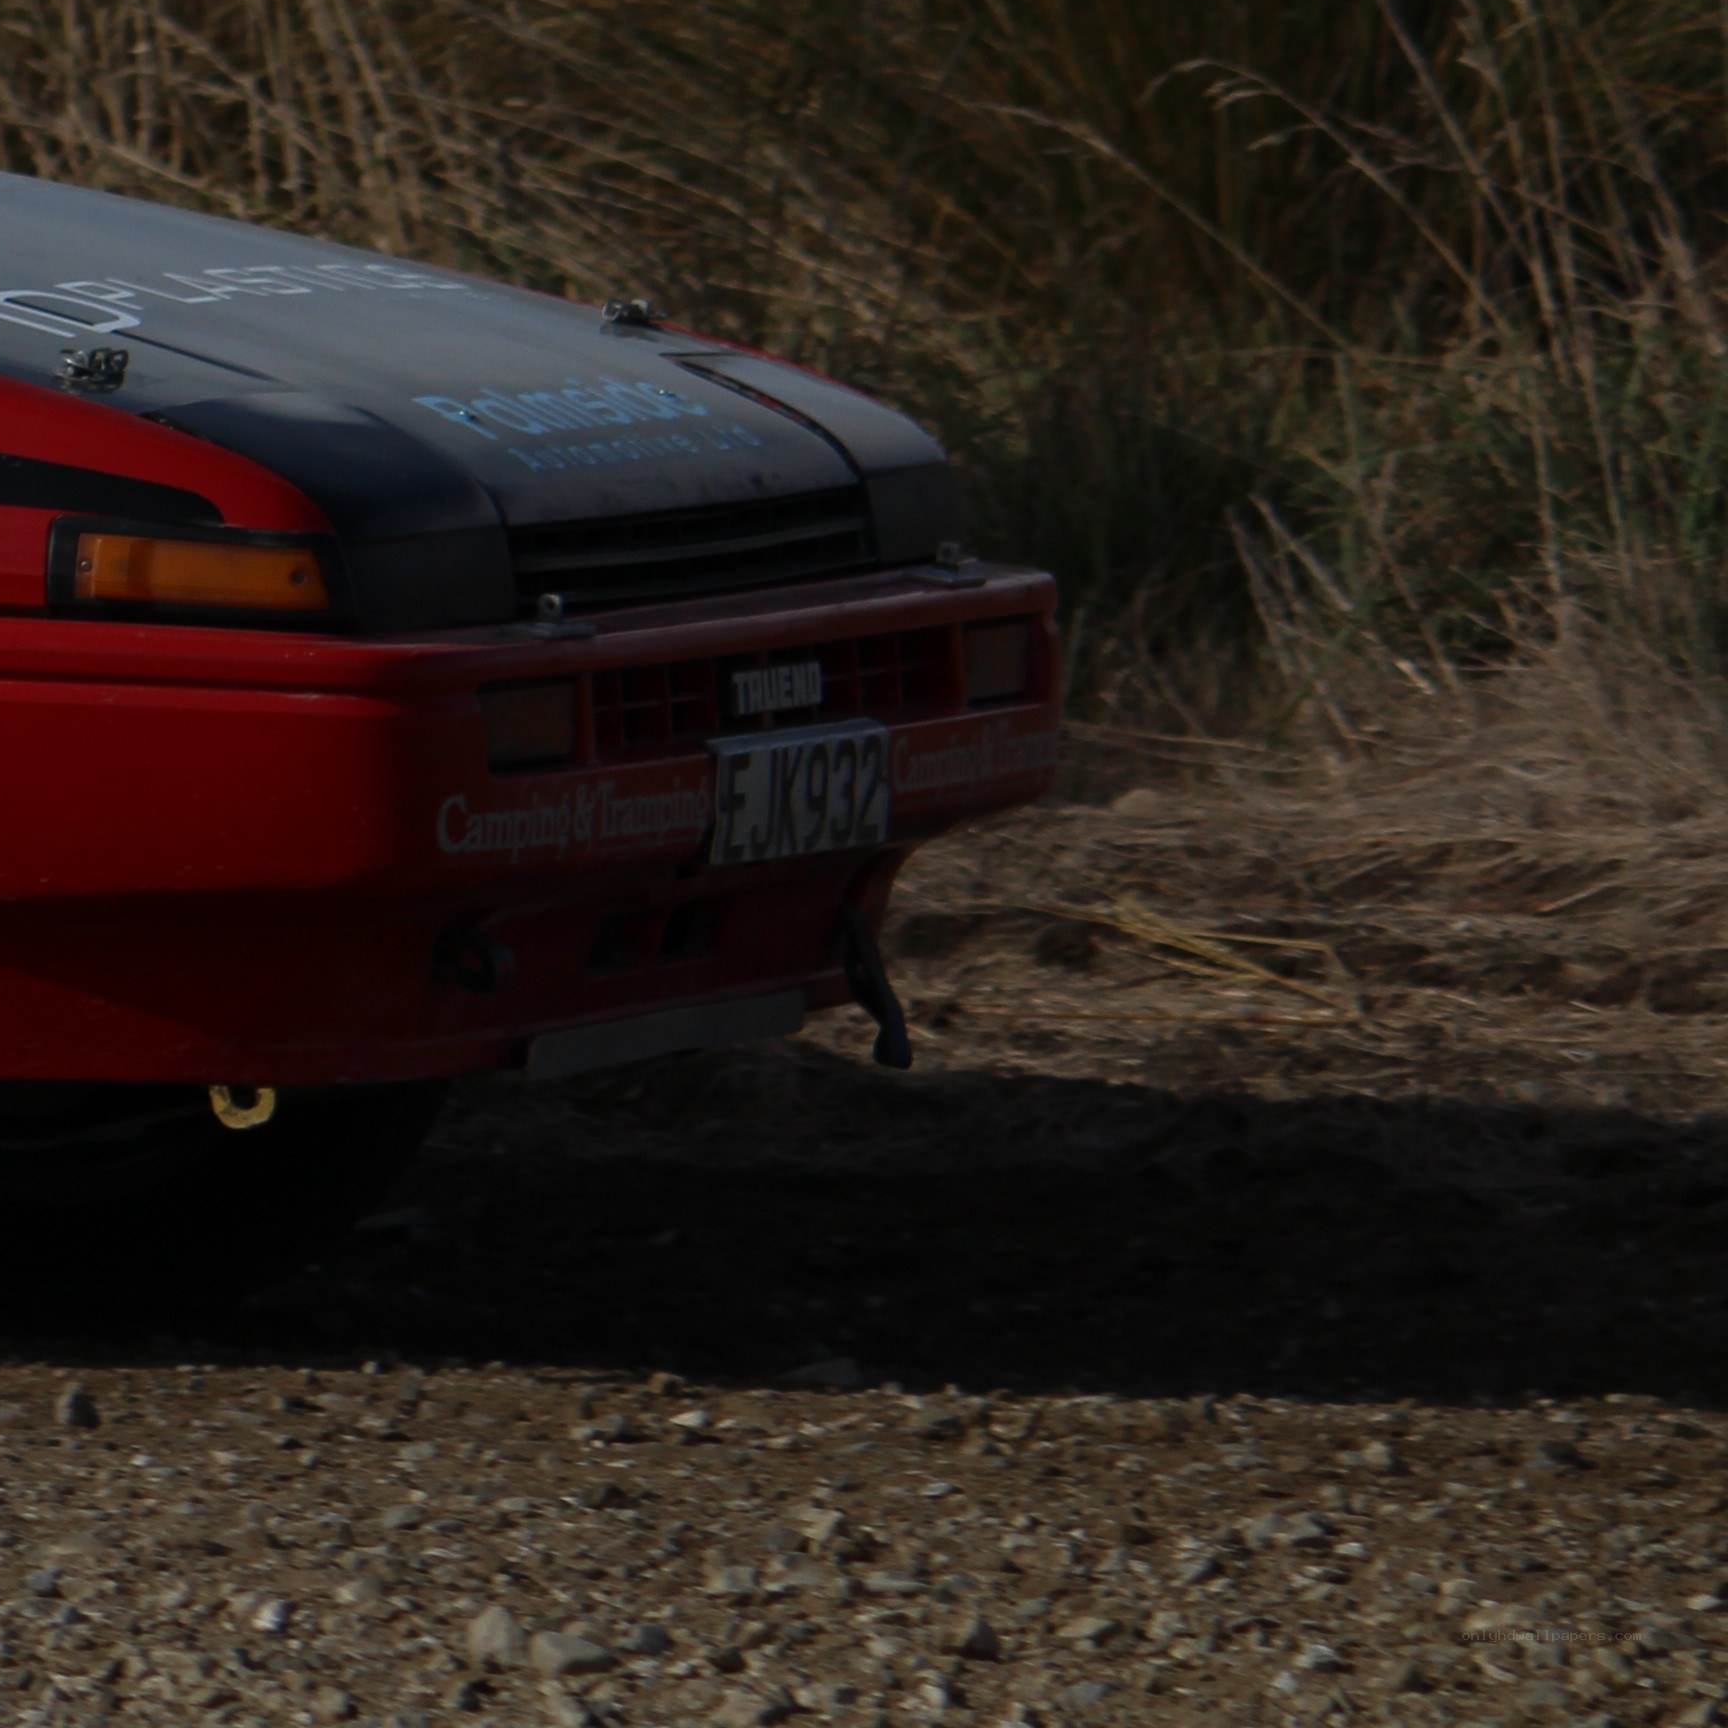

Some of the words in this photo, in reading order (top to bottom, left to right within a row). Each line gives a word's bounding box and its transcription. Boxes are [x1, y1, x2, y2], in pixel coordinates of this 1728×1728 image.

[435, 791, 570, 863] Camping
[597, 776, 711, 846] Tramping
[718, 735, 883, 862] EJK932
